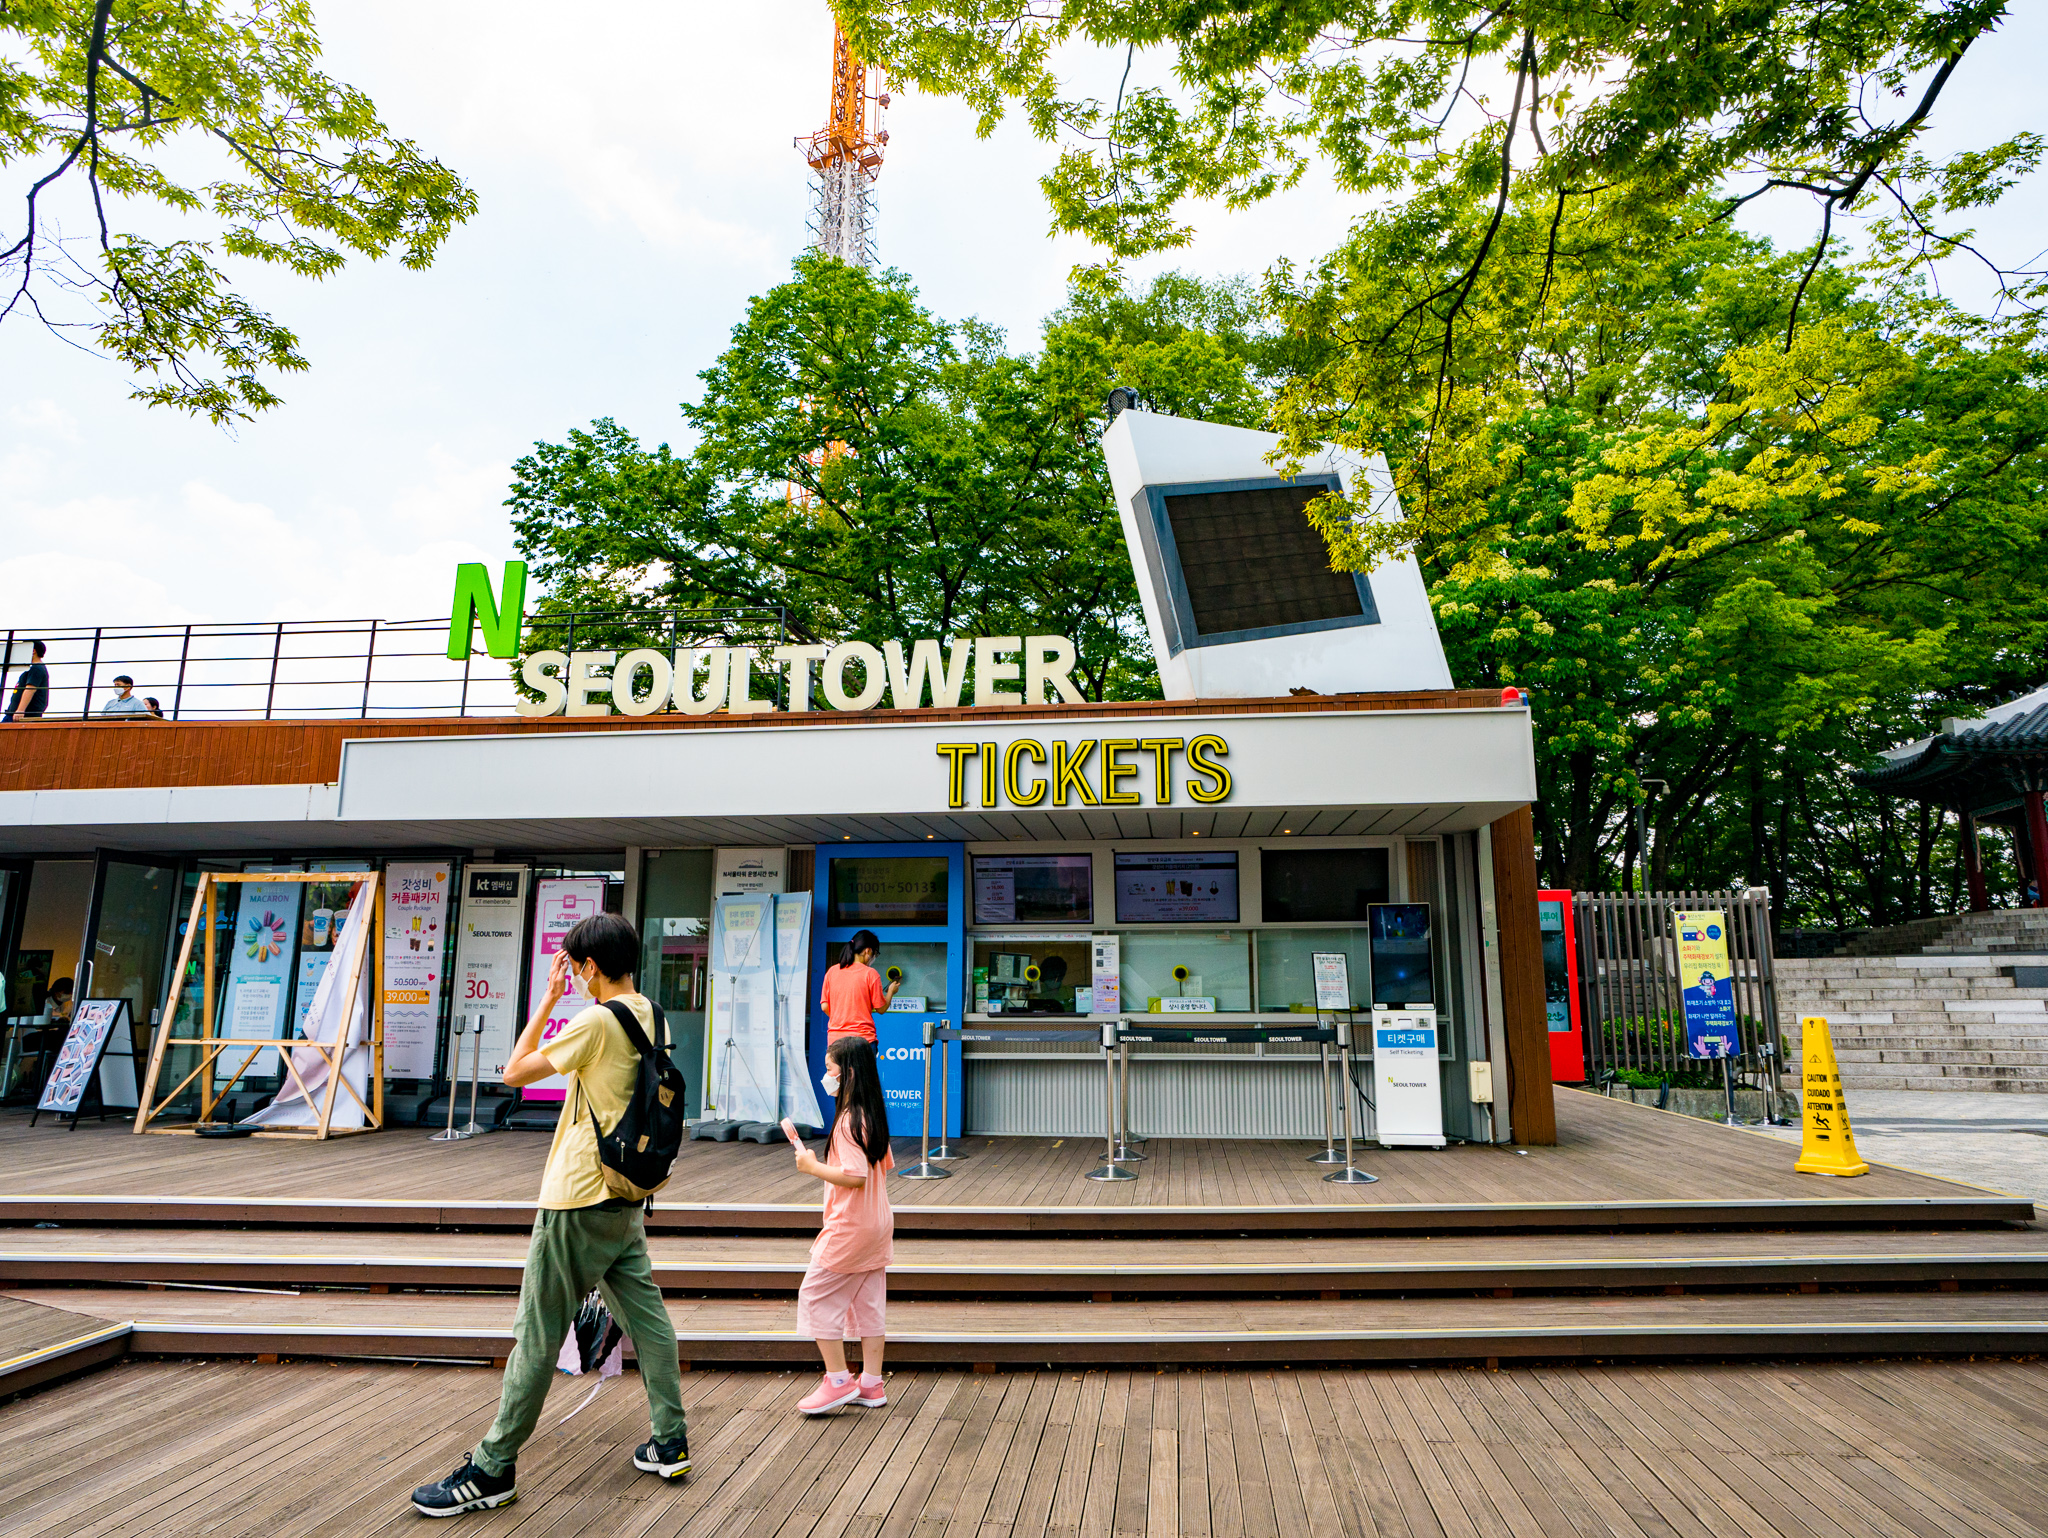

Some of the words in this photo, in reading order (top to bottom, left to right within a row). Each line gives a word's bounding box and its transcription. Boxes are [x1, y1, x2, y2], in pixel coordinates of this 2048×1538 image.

[447, 561, 528, 660] N
[936, 734, 1233, 809] TICKETS
[402, 878, 432, 890] 갓성비
[476, 879, 490, 891] kt
[491, 881, 513, 891] 멤버십
[249, 894, 289, 903] MACARON
[391, 892, 440, 904] 커플패키지
[467, 923, 474, 932] N
[1387, 1034, 1425, 1044] 티켓구매
[495, 1065, 505, 1074] kt
[1807, 1073, 1827, 1082] CAUTION
[1807, 1088, 1830, 1097] CUIDADO
[1807, 1102, 1833, 1111] ATTENTION
